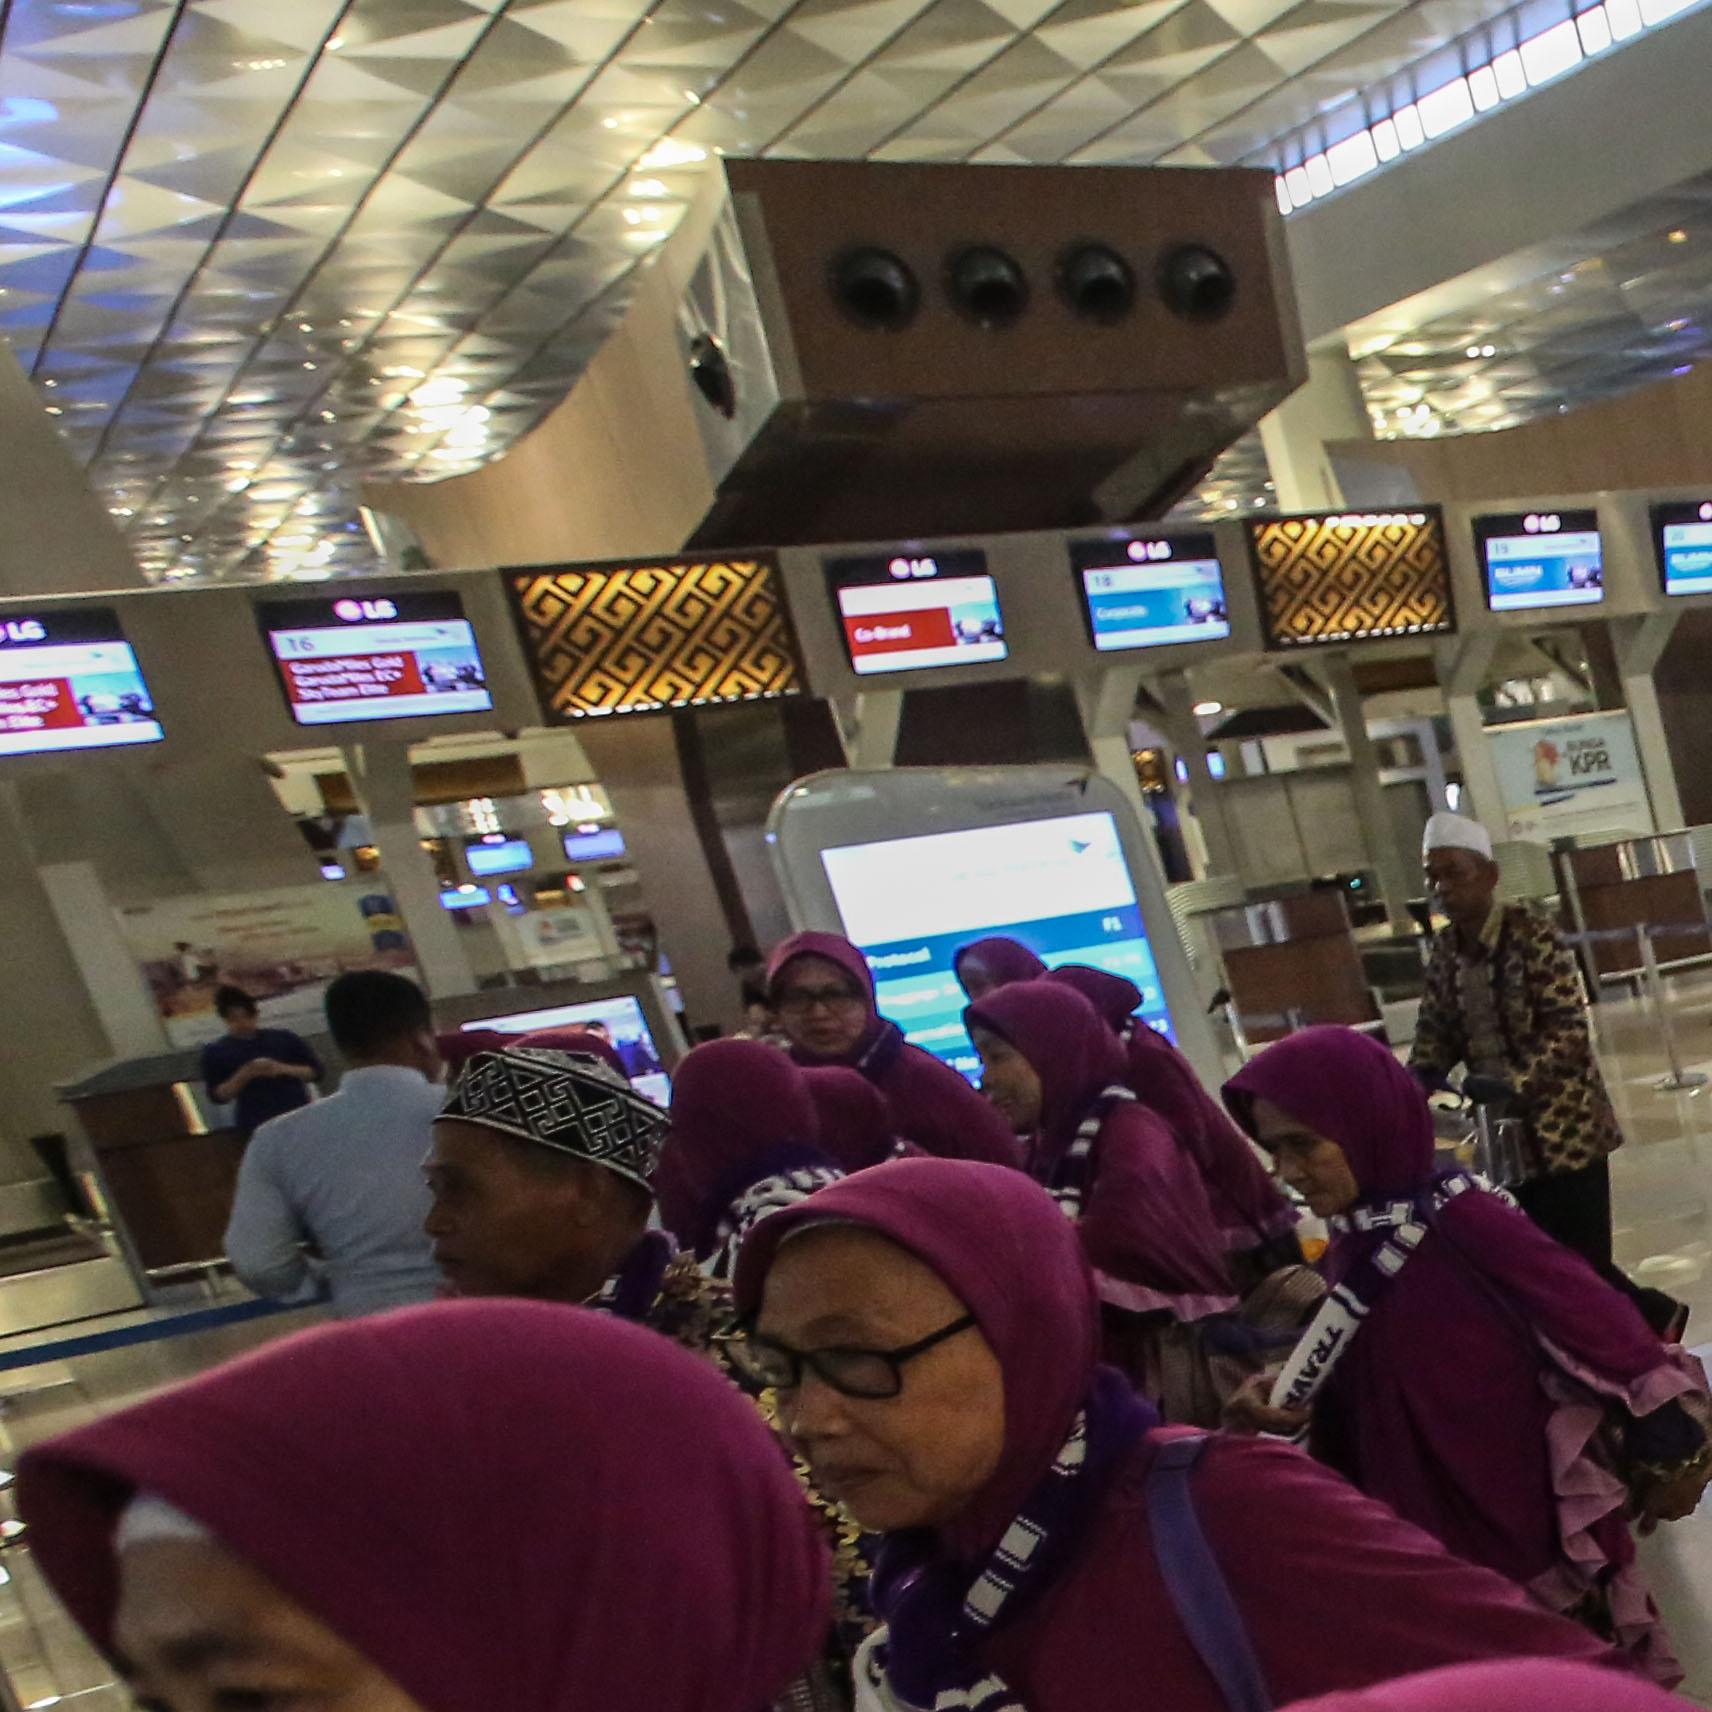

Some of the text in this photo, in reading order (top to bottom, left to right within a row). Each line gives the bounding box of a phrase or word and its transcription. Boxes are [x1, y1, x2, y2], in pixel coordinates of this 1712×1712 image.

[361, 599, 399, 619] LG
[6, 620, 48, 642] LG
[286, 637, 315, 652] 16
[1569, 750, 1613, 776] KPR
